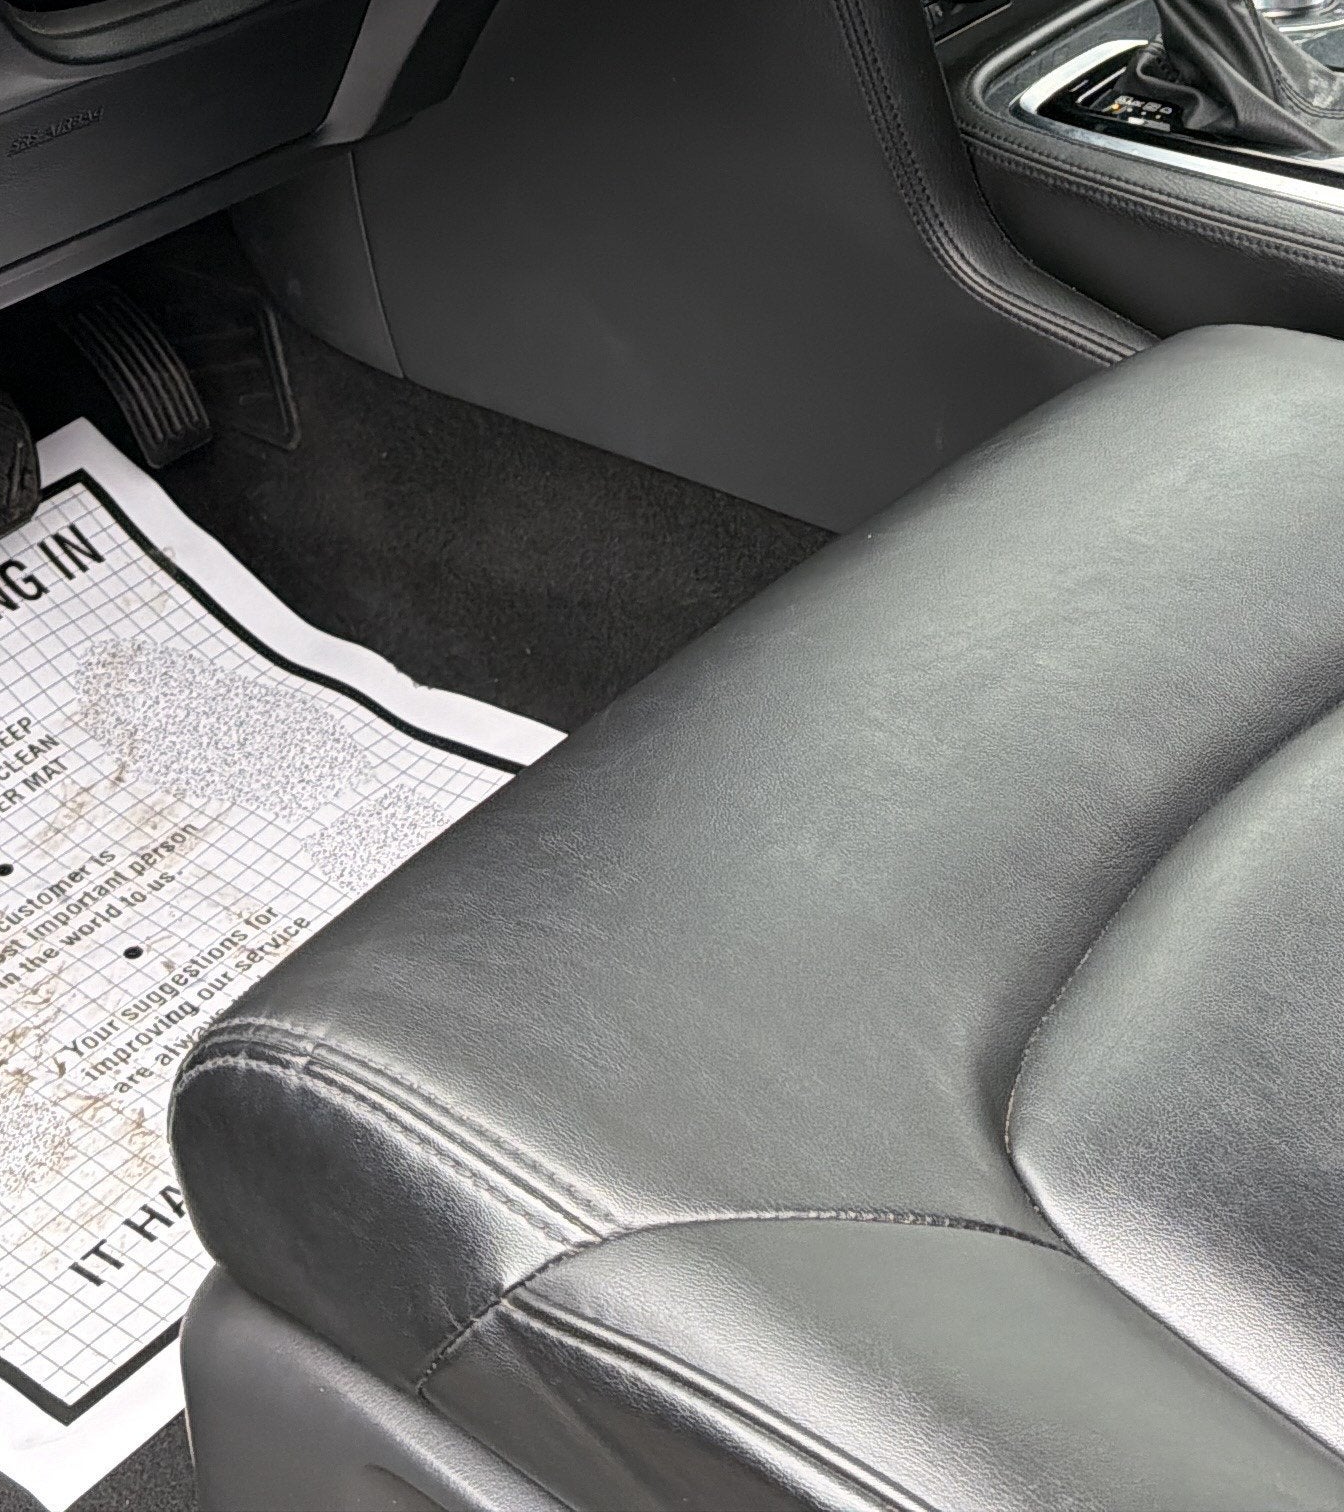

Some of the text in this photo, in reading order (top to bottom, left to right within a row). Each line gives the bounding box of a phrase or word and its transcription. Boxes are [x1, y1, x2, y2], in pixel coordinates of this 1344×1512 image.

[36, 523, 107, 581] IN
[21, 756, 69, 794] MAT
[22, 869, 130, 942] important
[129, 822, 200, 877] person
[88, 849, 117, 868] is
[19, 945, 60, 974] the
[59, 903, 123, 947] world
[119, 889, 148, 910] to
[63, 1018, 122, 1059] Your
[121, 928, 249, 1022] suggestions
[243, 905, 280, 931] for
[80, 916, 312, 1082] improving our service
[113, 1064, 155, 1095] are
[69, 1185, 186, 1287] IT HA
